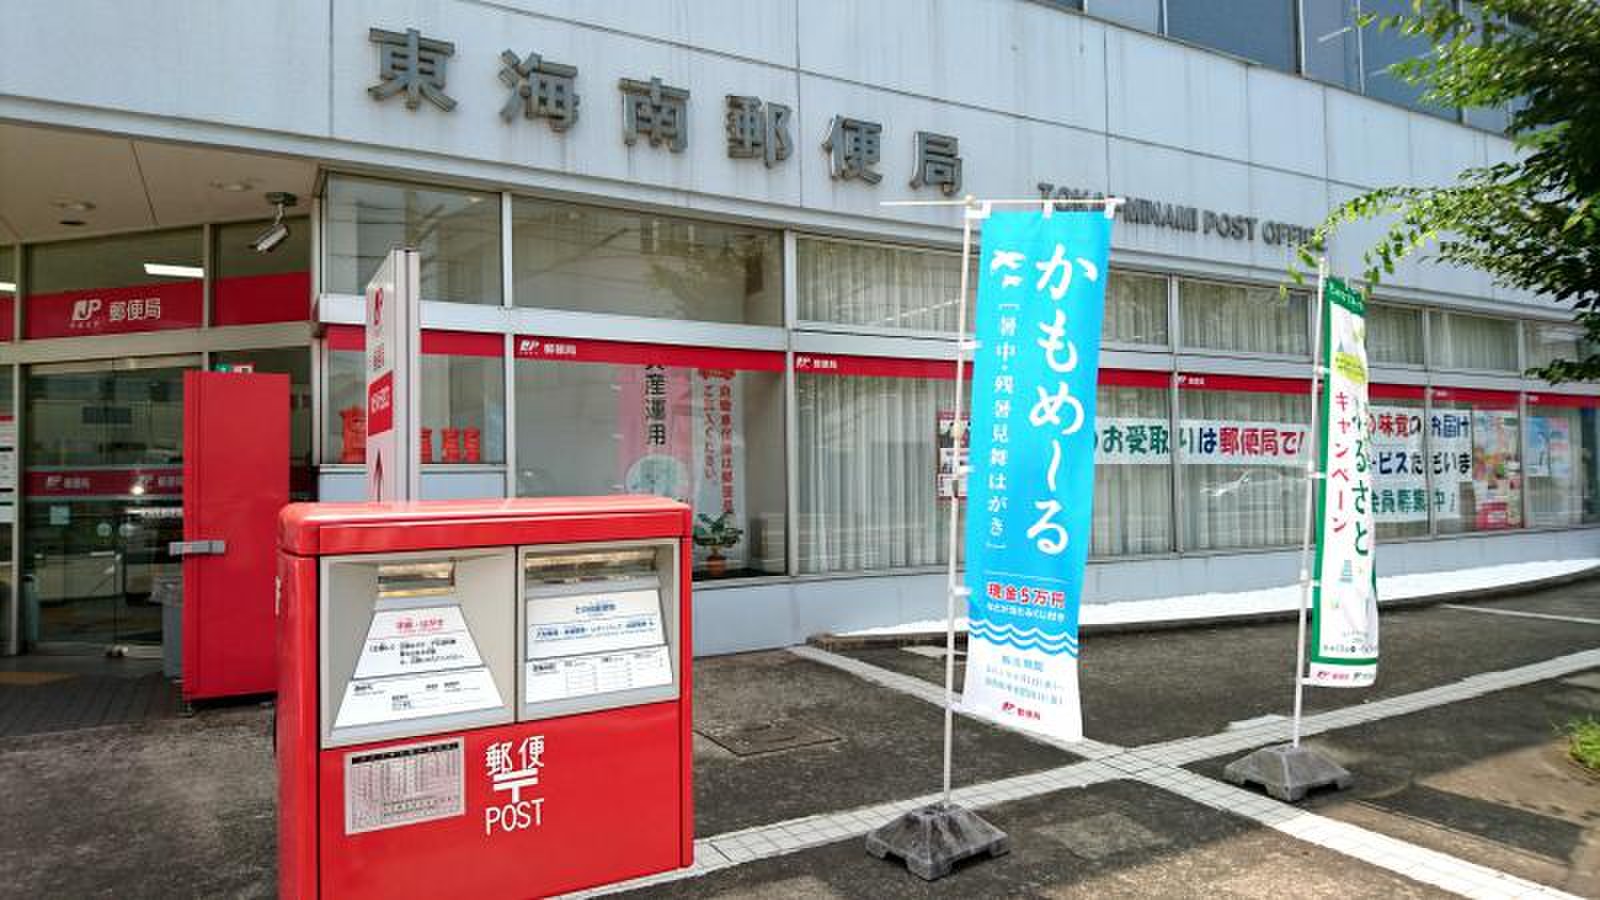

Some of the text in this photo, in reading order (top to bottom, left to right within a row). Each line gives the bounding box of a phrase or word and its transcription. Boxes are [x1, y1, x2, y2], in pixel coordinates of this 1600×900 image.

[368, 27, 965, 196] 東海南郵便局
[1203, 210, 1258, 241] POST
[109, 298, 161, 321] 郵便局
[1331, 392, 1350, 533] キャンペーン
[485, 735, 546, 776] 郵便
[485, 798, 546, 836] POST
